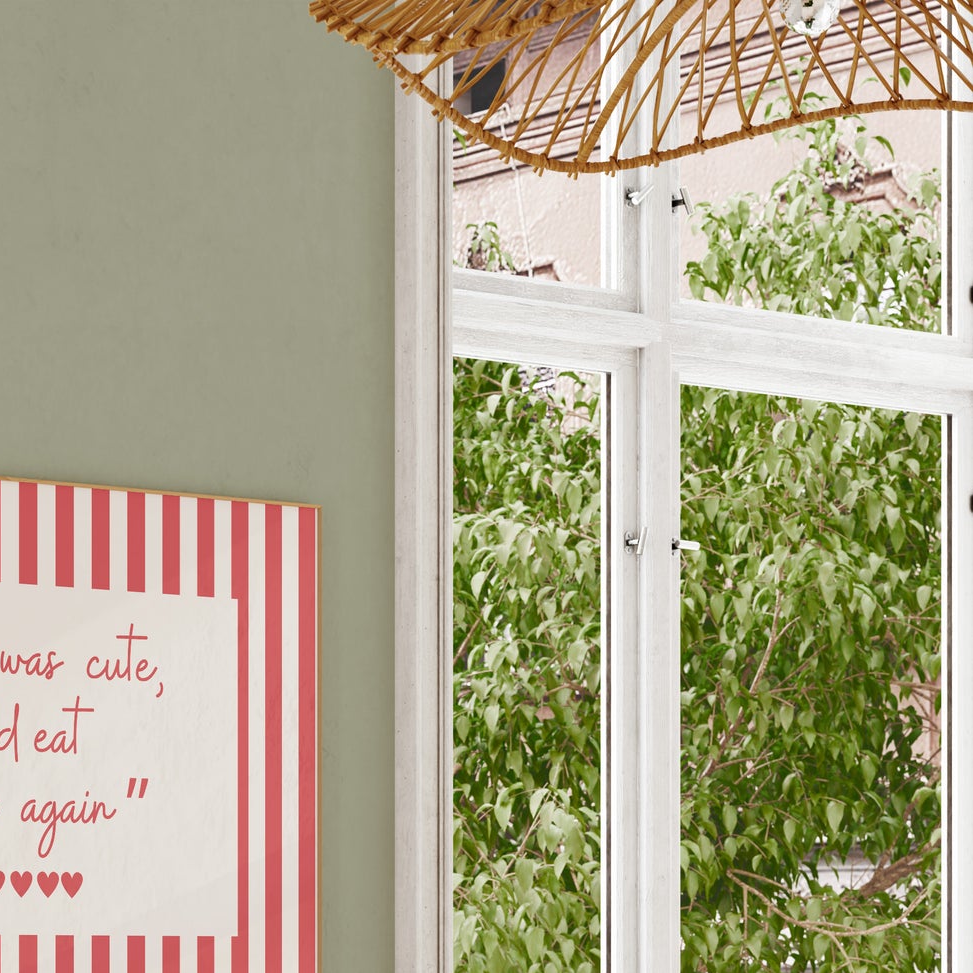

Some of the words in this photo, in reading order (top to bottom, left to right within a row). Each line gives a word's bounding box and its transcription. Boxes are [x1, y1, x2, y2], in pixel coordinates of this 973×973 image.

[0, 651, 64, 680] was
[86, 623, 164, 698] cute,
[34, 695, 95, 754] eat
